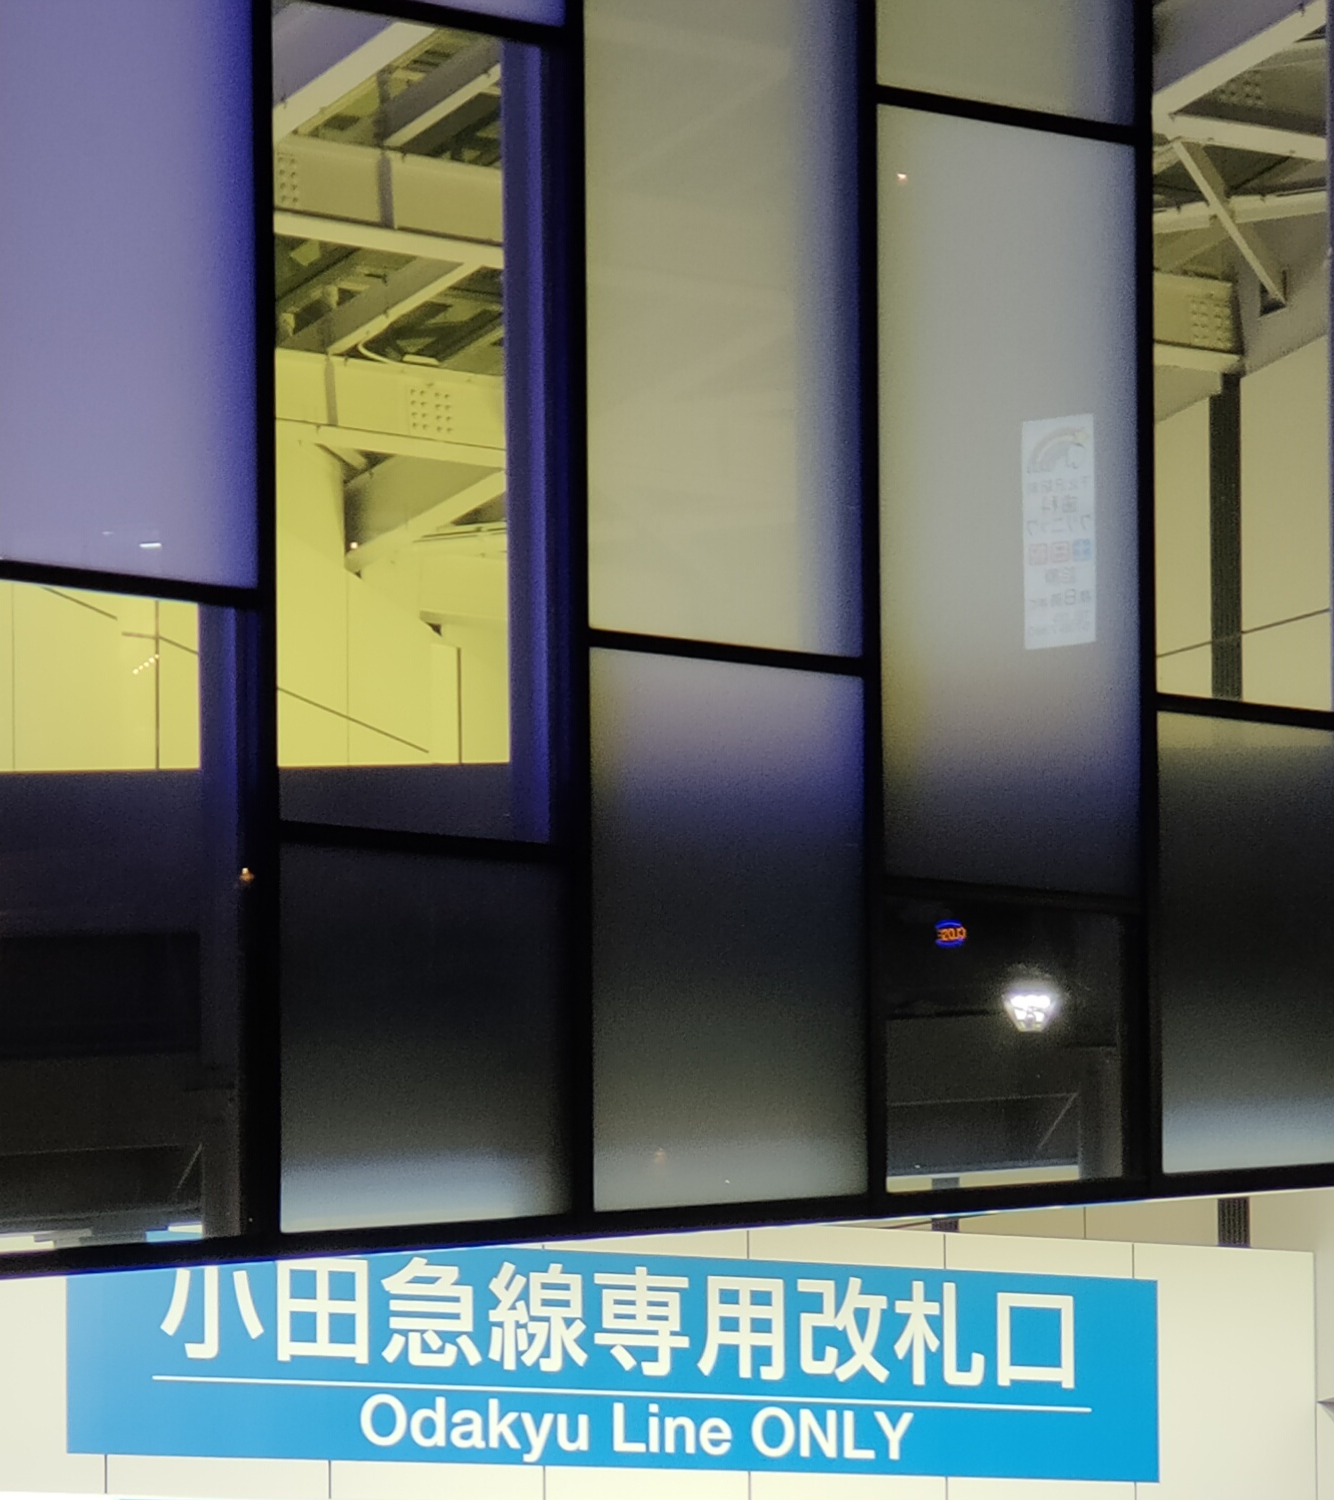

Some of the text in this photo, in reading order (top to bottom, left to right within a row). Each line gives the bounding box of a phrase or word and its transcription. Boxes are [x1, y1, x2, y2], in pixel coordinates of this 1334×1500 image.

[160, 1256, 1075, 1389] 小田急線専用改札口
[360, 1393, 915, 1463] Odakyu Line ONLY
